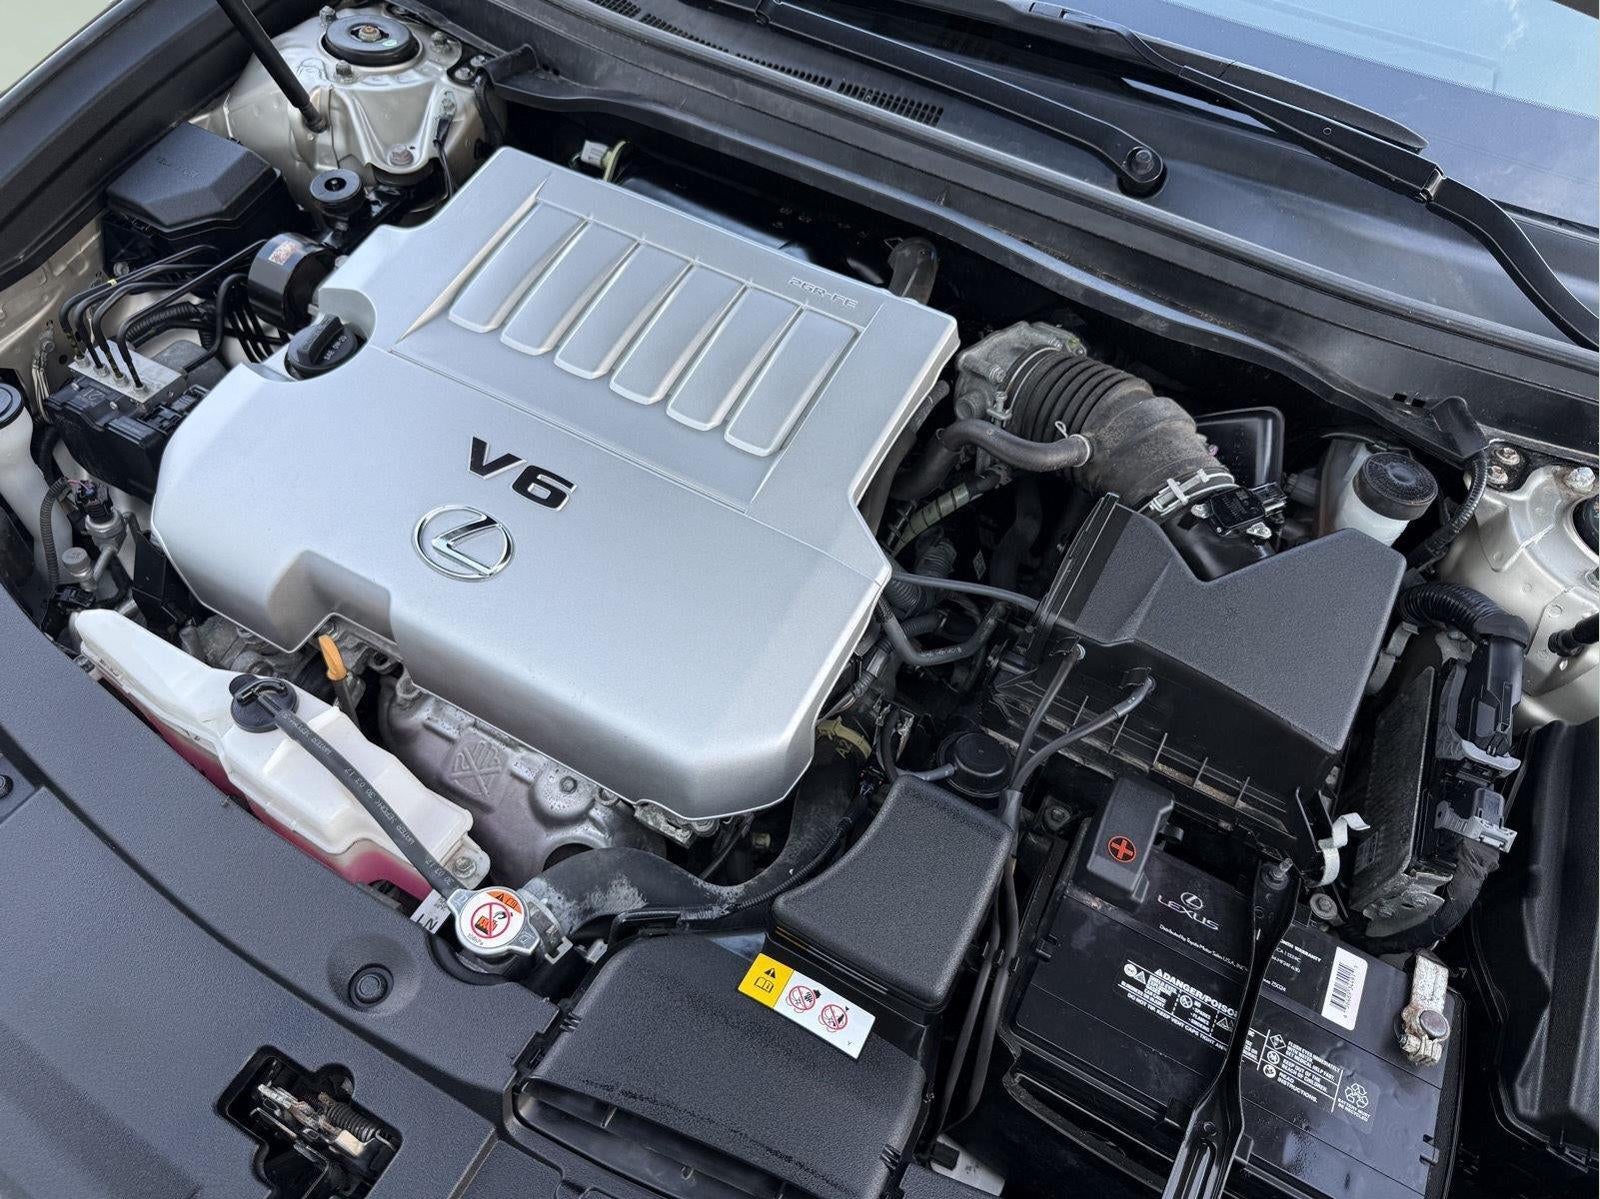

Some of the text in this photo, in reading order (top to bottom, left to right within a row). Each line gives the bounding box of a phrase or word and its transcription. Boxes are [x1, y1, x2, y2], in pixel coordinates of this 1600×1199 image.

[788, 275, 858, 308] 2GR-FE
[468, 435, 577, 511] V6
[1157, 894, 1219, 931] LEXUS
[1293, 945, 1321, 962] WARRANTY
[1126, 992, 1136, 1000] DO
[1134, 997, 1147, 1006] NOT
[1155, 1008, 1171, 1020] KEEP
[1169, 1017, 1184, 1029] VENT
[1183, 1025, 1198, 1036] CAPS
[1282, 1058, 1295, 1068] KEEP
[1294, 1064, 1305, 1073] OUT
[1311, 1064, 1323, 1074] HELP
[1276, 1076, 1318, 1102] INSTRUCTIONS.
